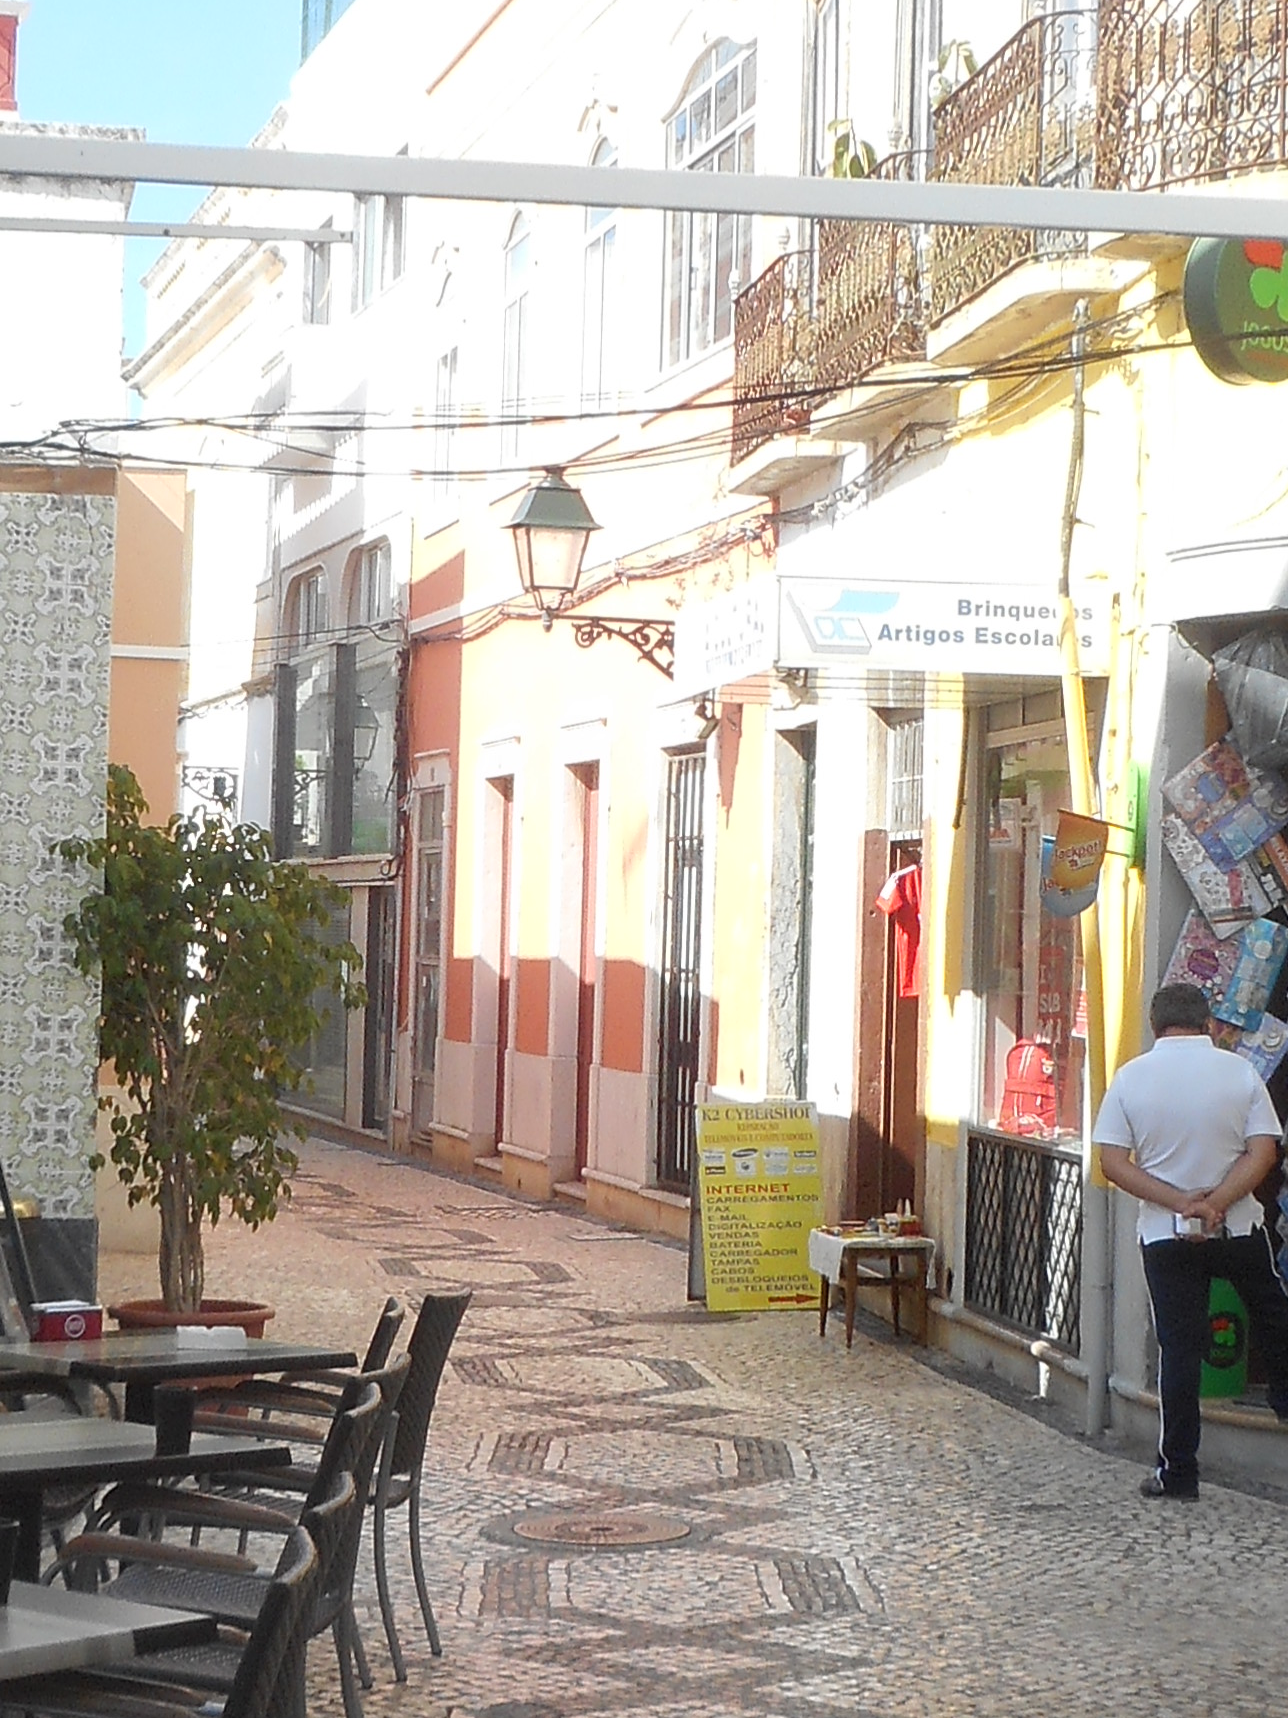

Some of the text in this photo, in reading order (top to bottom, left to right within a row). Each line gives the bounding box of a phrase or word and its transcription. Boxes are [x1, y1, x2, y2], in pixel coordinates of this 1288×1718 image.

[877, 623, 1093, 648] Artigos Escolas
[702, 1108, 720, 1121] K2
[706, 1183, 790, 1195] INTERNET
[706, 1194, 819, 1204] CARREGAMENTOS
[707, 1205, 731, 1213] FAX
[709, 1221, 802, 1231] DIGITALIZAÇÃO
[709, 1231, 759, 1240] VENDAS
[711, 1258, 760, 1266] TAMPAS
[710, 1267, 755, 1275] CABOS
